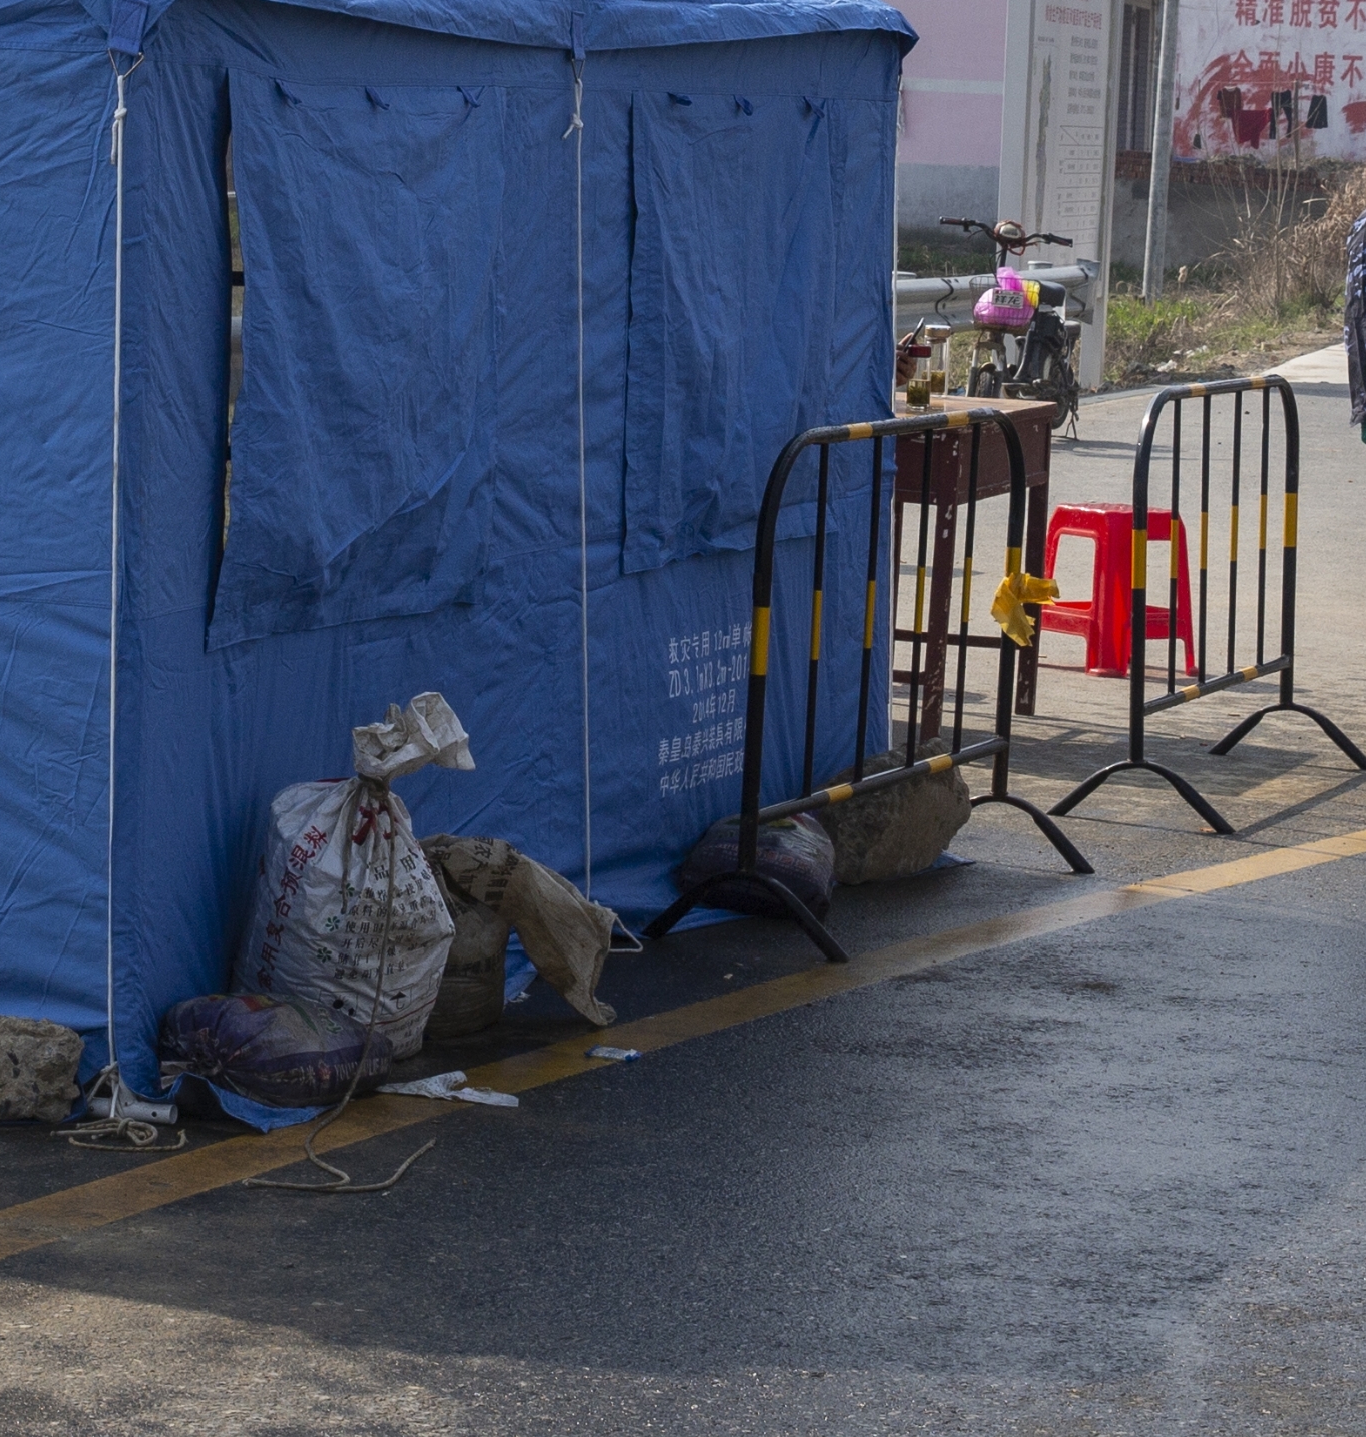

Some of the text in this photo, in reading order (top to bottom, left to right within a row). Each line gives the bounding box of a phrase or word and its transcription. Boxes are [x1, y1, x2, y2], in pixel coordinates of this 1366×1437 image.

[669, 630, 710, 664] 救灾专用
[658, 717, 747, 765] 秦皇岛秦兴装具有限
